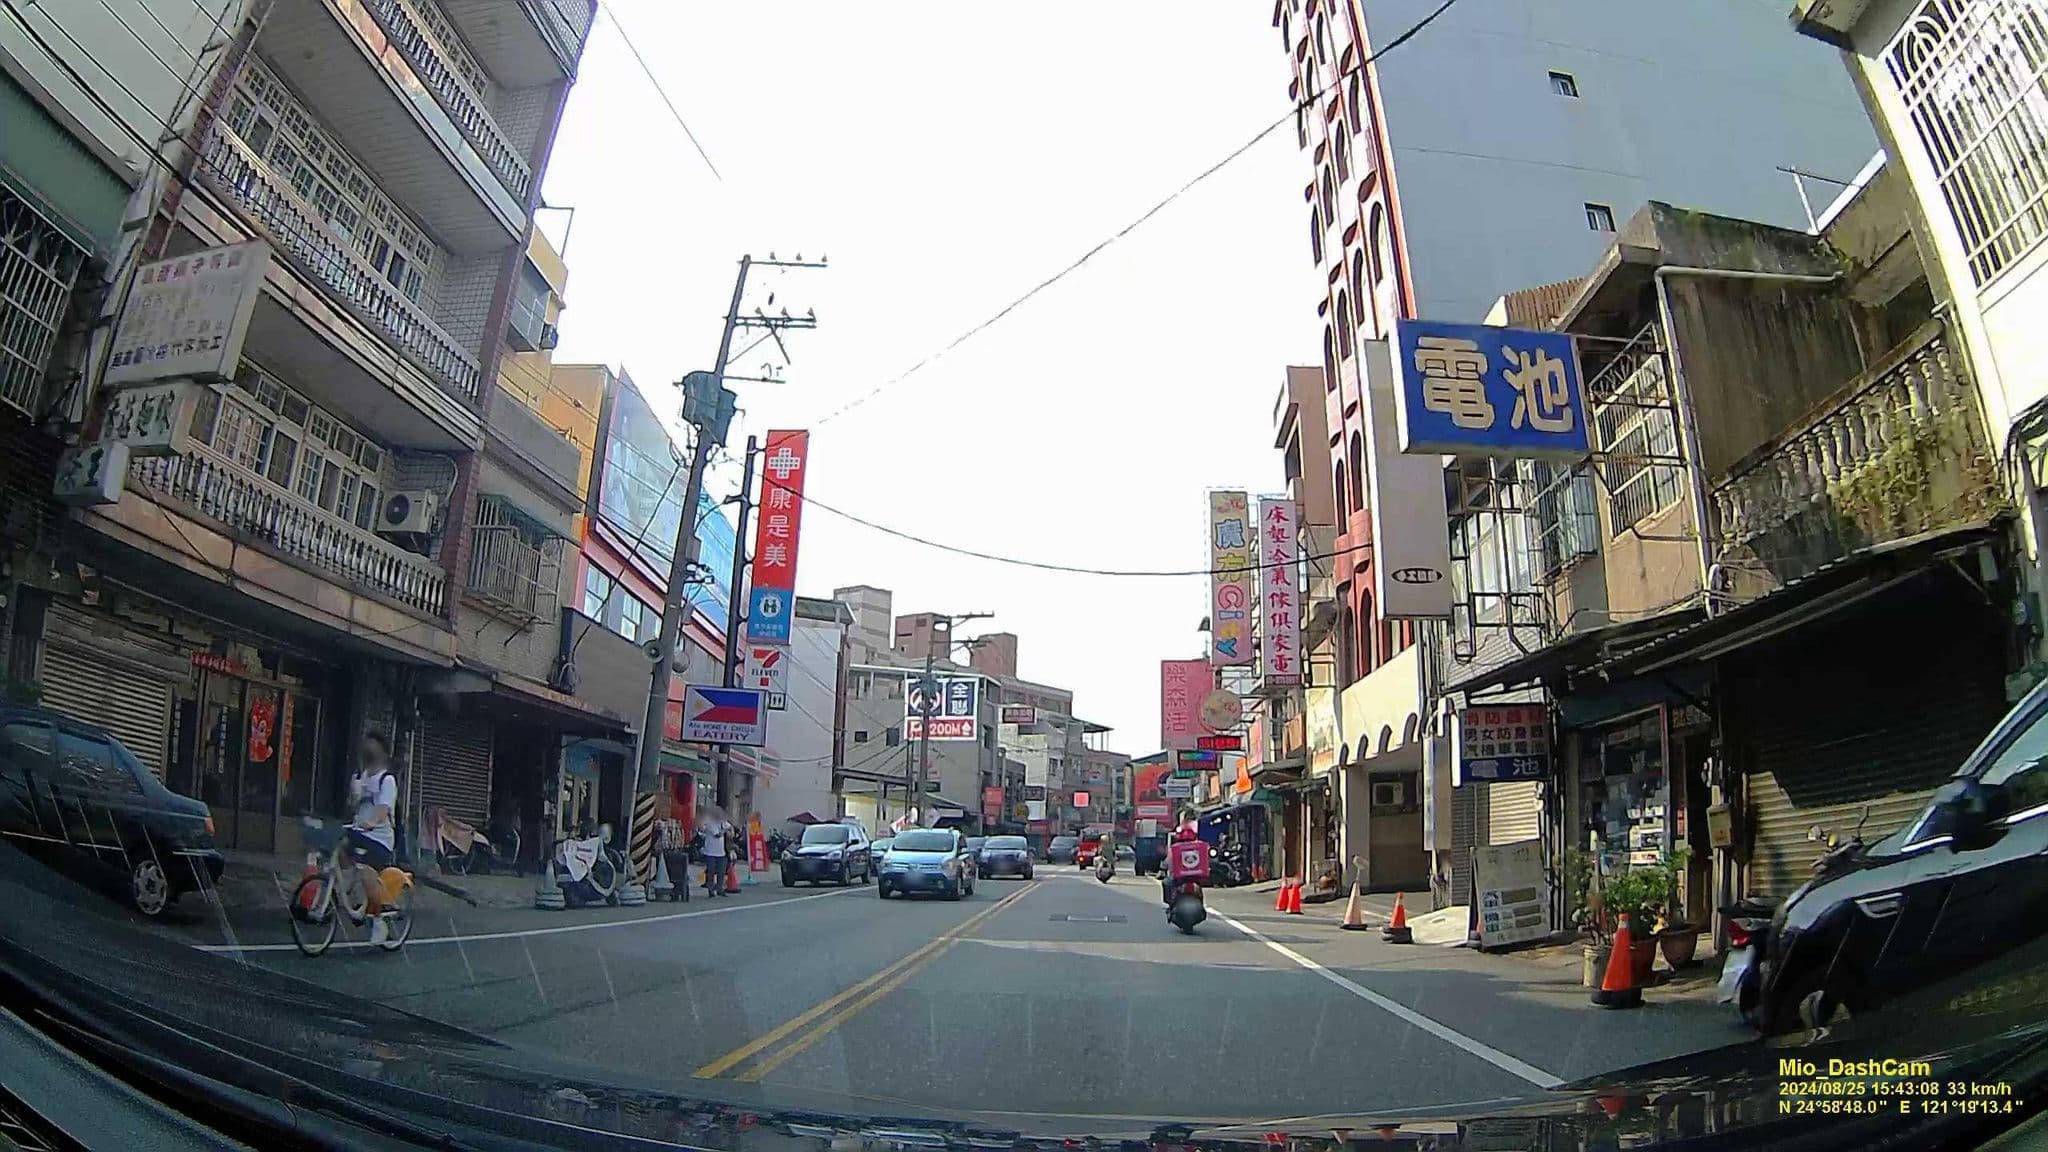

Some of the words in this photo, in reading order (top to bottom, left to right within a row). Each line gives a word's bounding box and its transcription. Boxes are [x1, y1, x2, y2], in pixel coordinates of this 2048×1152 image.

[1414, 337, 1574, 433] 電池
[763, 487, 792, 568] 康是美
[951, 683, 969, 715] 全聯
[693, 729, 749, 740] EATERY
